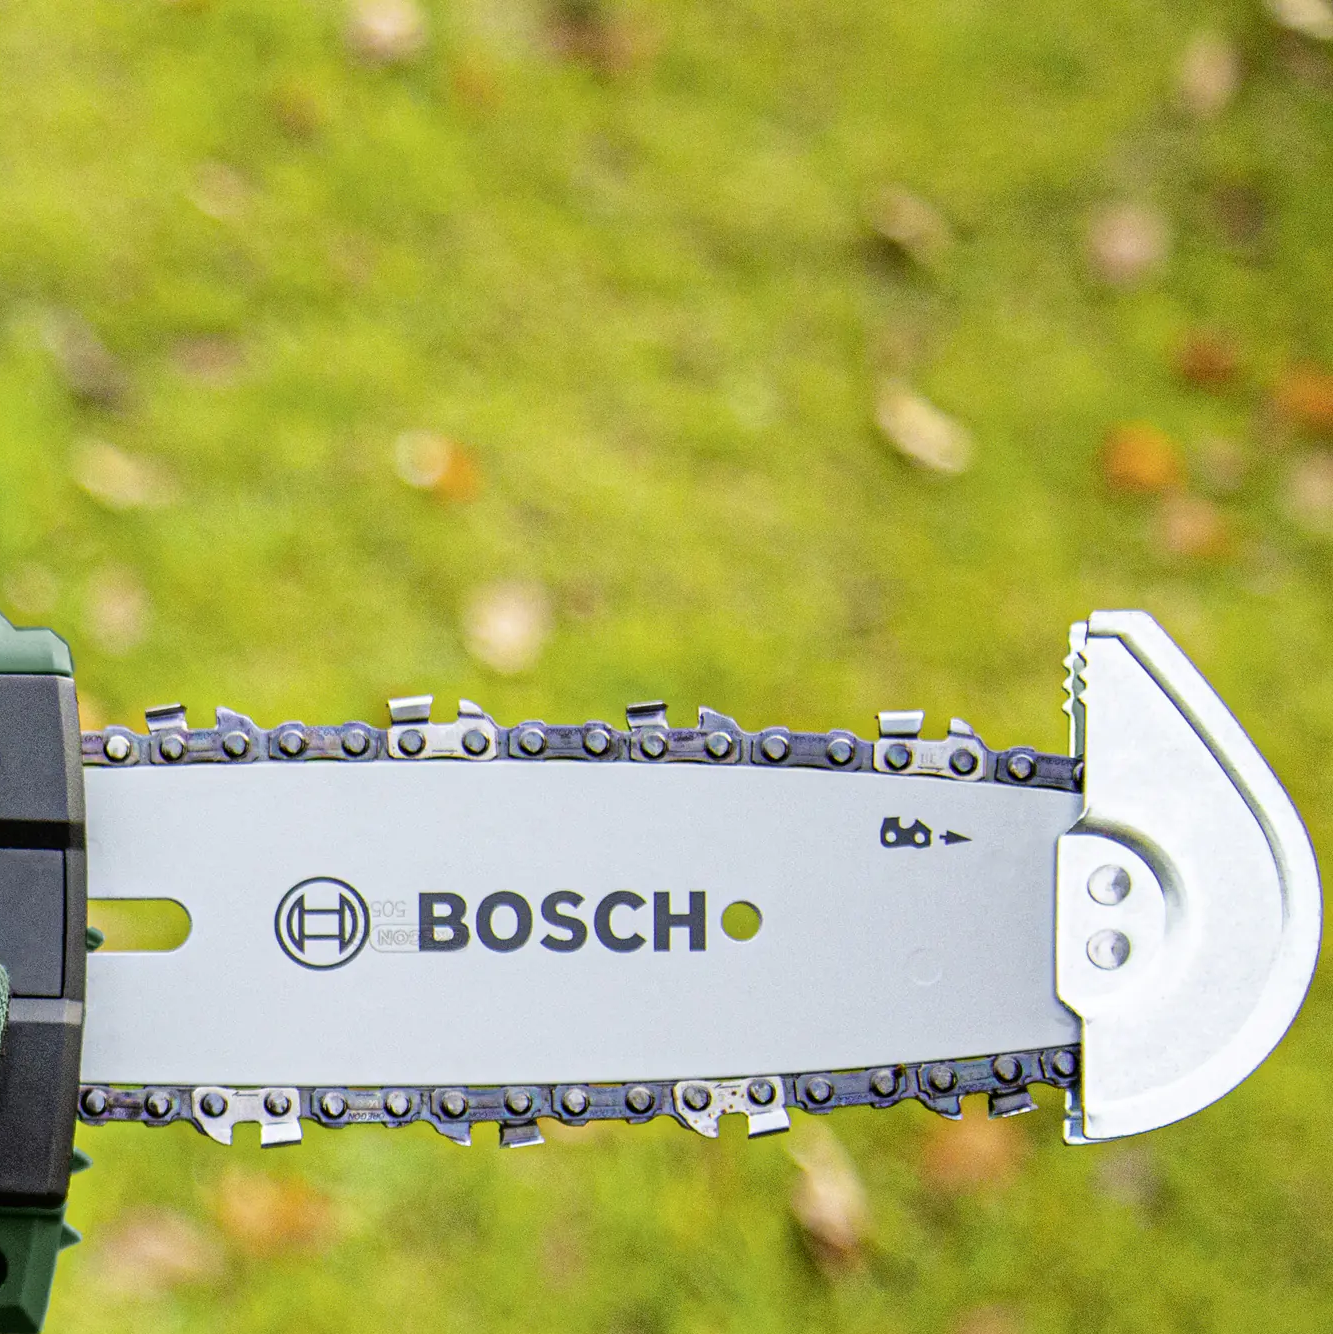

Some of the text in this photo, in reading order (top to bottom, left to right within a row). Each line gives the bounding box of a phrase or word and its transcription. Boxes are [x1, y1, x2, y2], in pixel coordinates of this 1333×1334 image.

[371, 901, 407, 917] 505
[418, 890, 707, 951] BOSCH
[348, 1112, 386, 1121] OREGON
